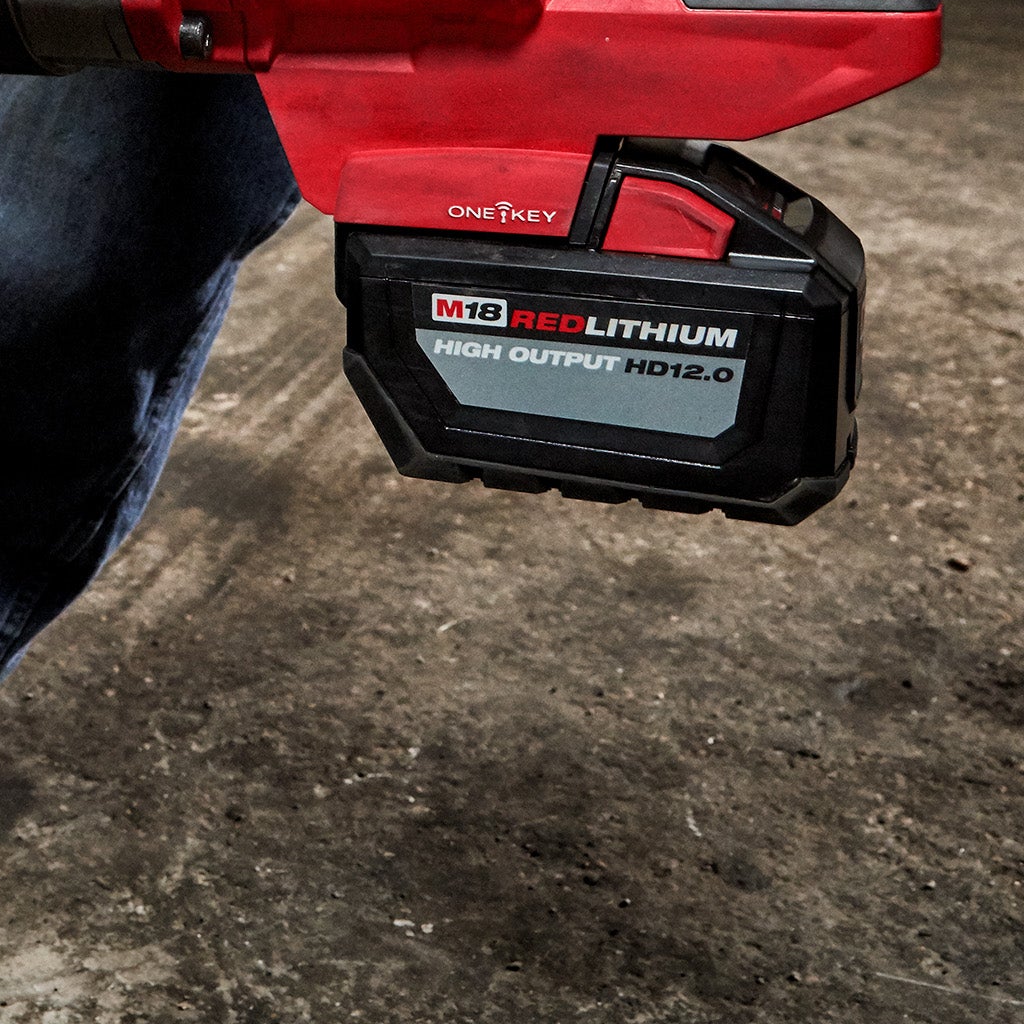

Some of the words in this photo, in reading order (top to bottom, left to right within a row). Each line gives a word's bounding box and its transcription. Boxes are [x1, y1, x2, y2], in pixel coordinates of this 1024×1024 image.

[435, 298, 503, 322] M18
[510, 309, 739, 349] REDLITHIUM
[433, 338, 502, 361] HIGH
[508, 345, 623, 373] OUTPUT
[624, 358, 736, 384] HD12.0
